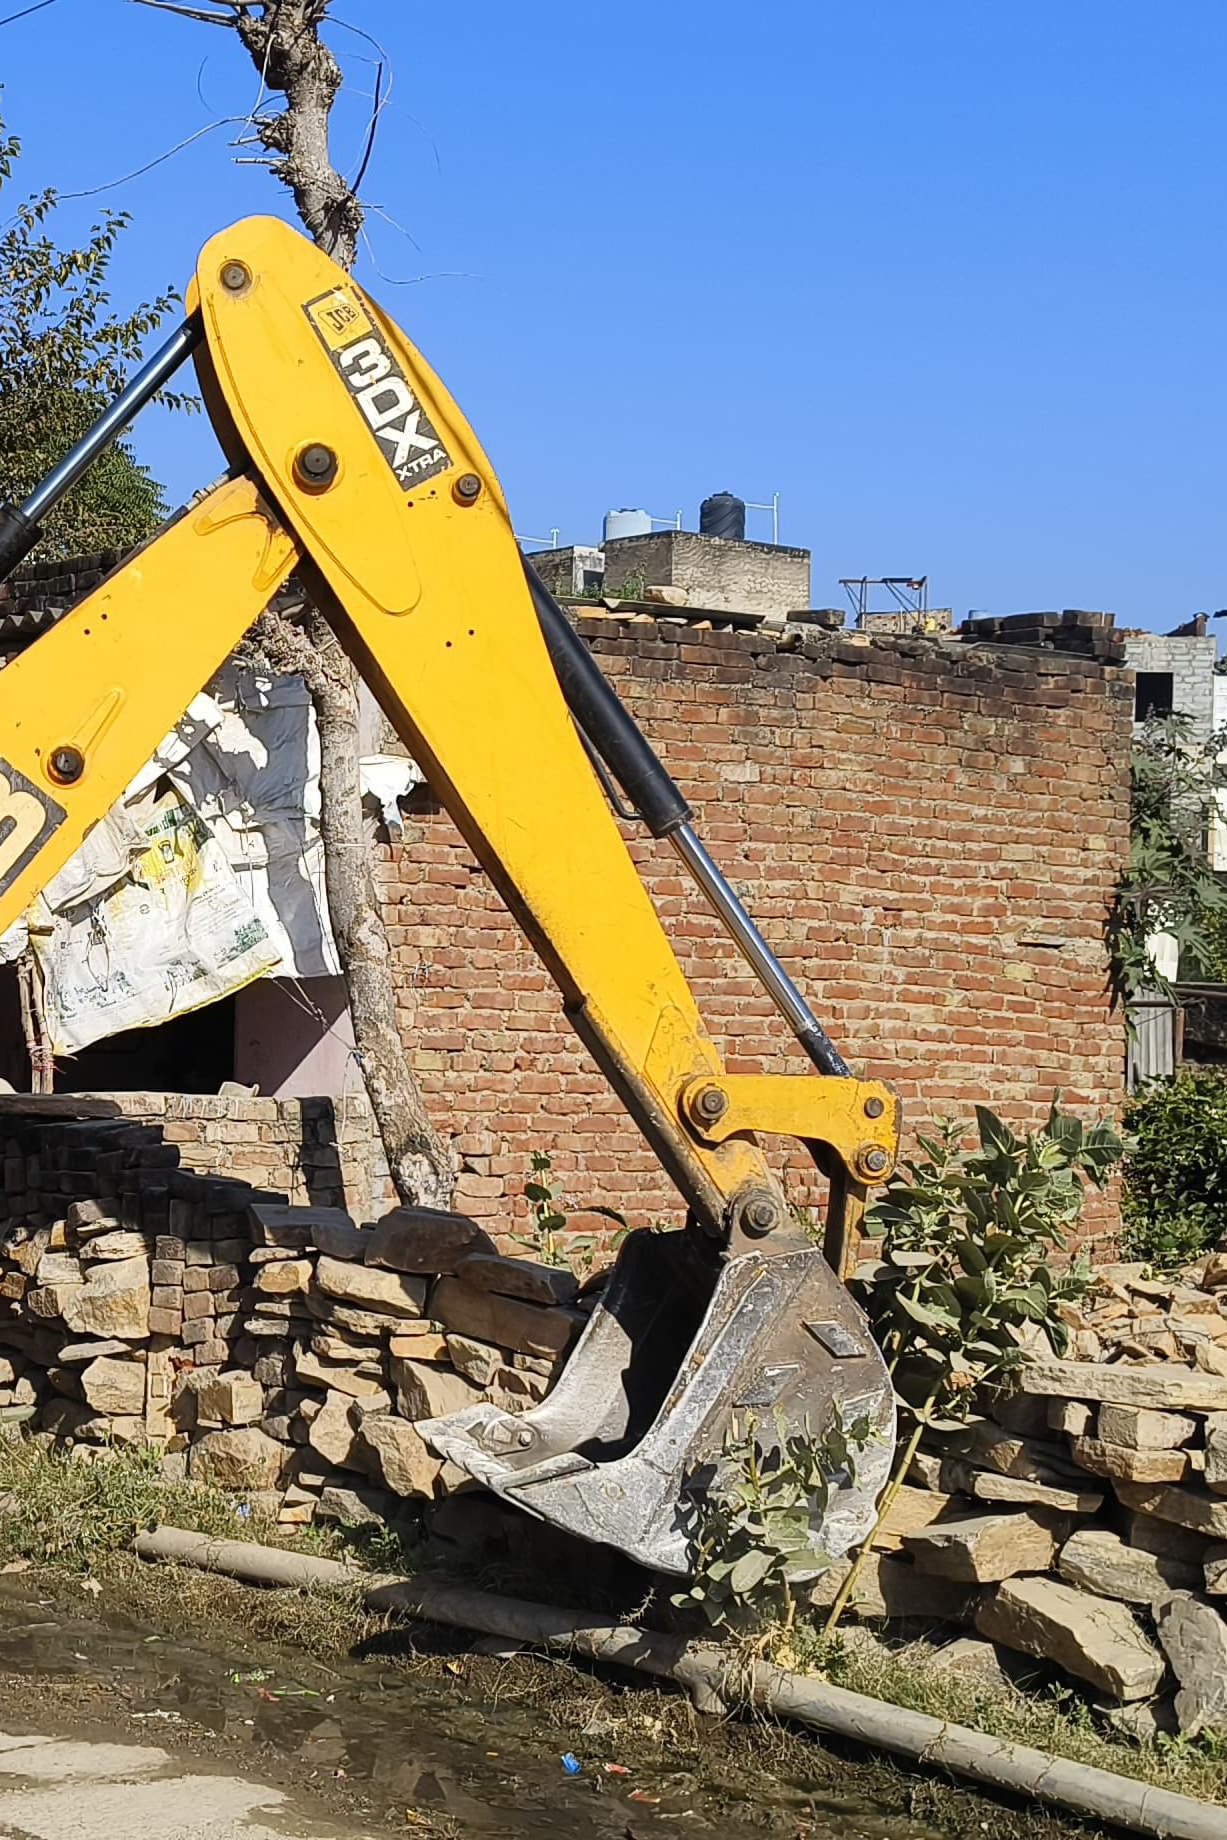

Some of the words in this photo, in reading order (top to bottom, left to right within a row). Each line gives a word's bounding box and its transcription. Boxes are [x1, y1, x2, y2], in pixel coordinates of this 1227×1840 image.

[326, 304, 356, 333] JCB
[340, 338, 439, 468] 3DX
[395, 449, 447, 482] XTRA
